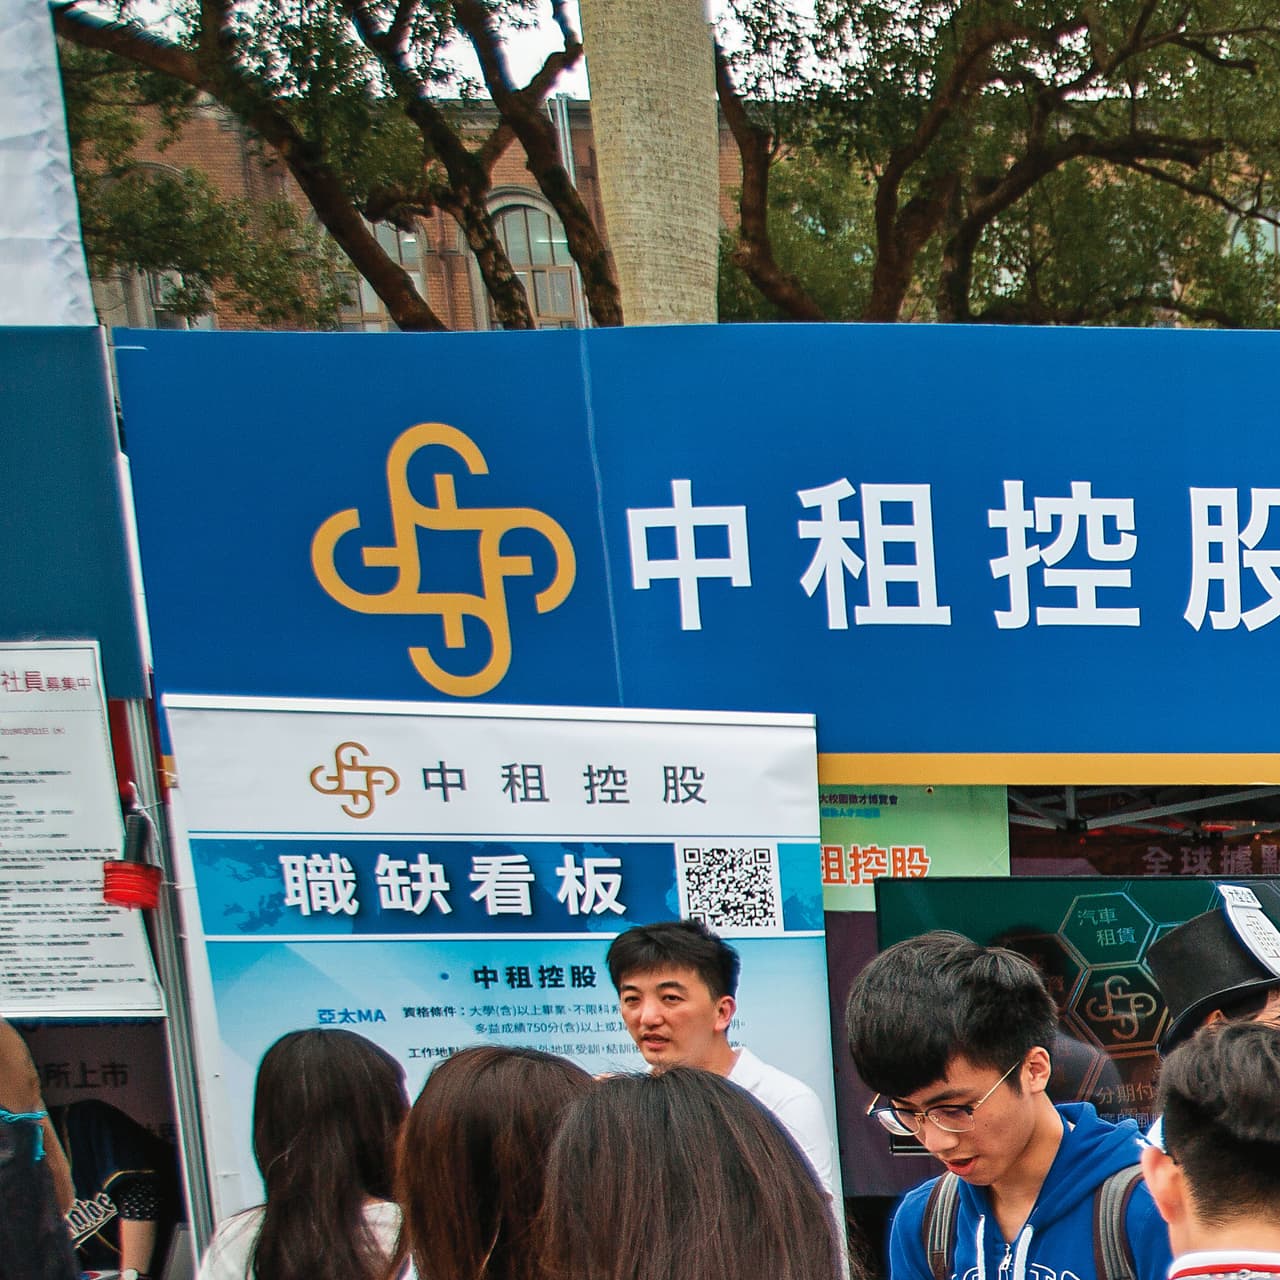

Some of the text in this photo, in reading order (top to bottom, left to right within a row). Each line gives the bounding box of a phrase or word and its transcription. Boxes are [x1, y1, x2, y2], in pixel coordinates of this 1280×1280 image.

[422, 761, 708, 806] 中租控股
[281, 852, 628, 918] 職缺看板
[1077, 907, 1117, 926] 汽車
[1096, 927, 1137, 946] 租賃
[472, 964, 598, 989] 中租控股
[317, 1007, 387, 1025] 亞太MA
